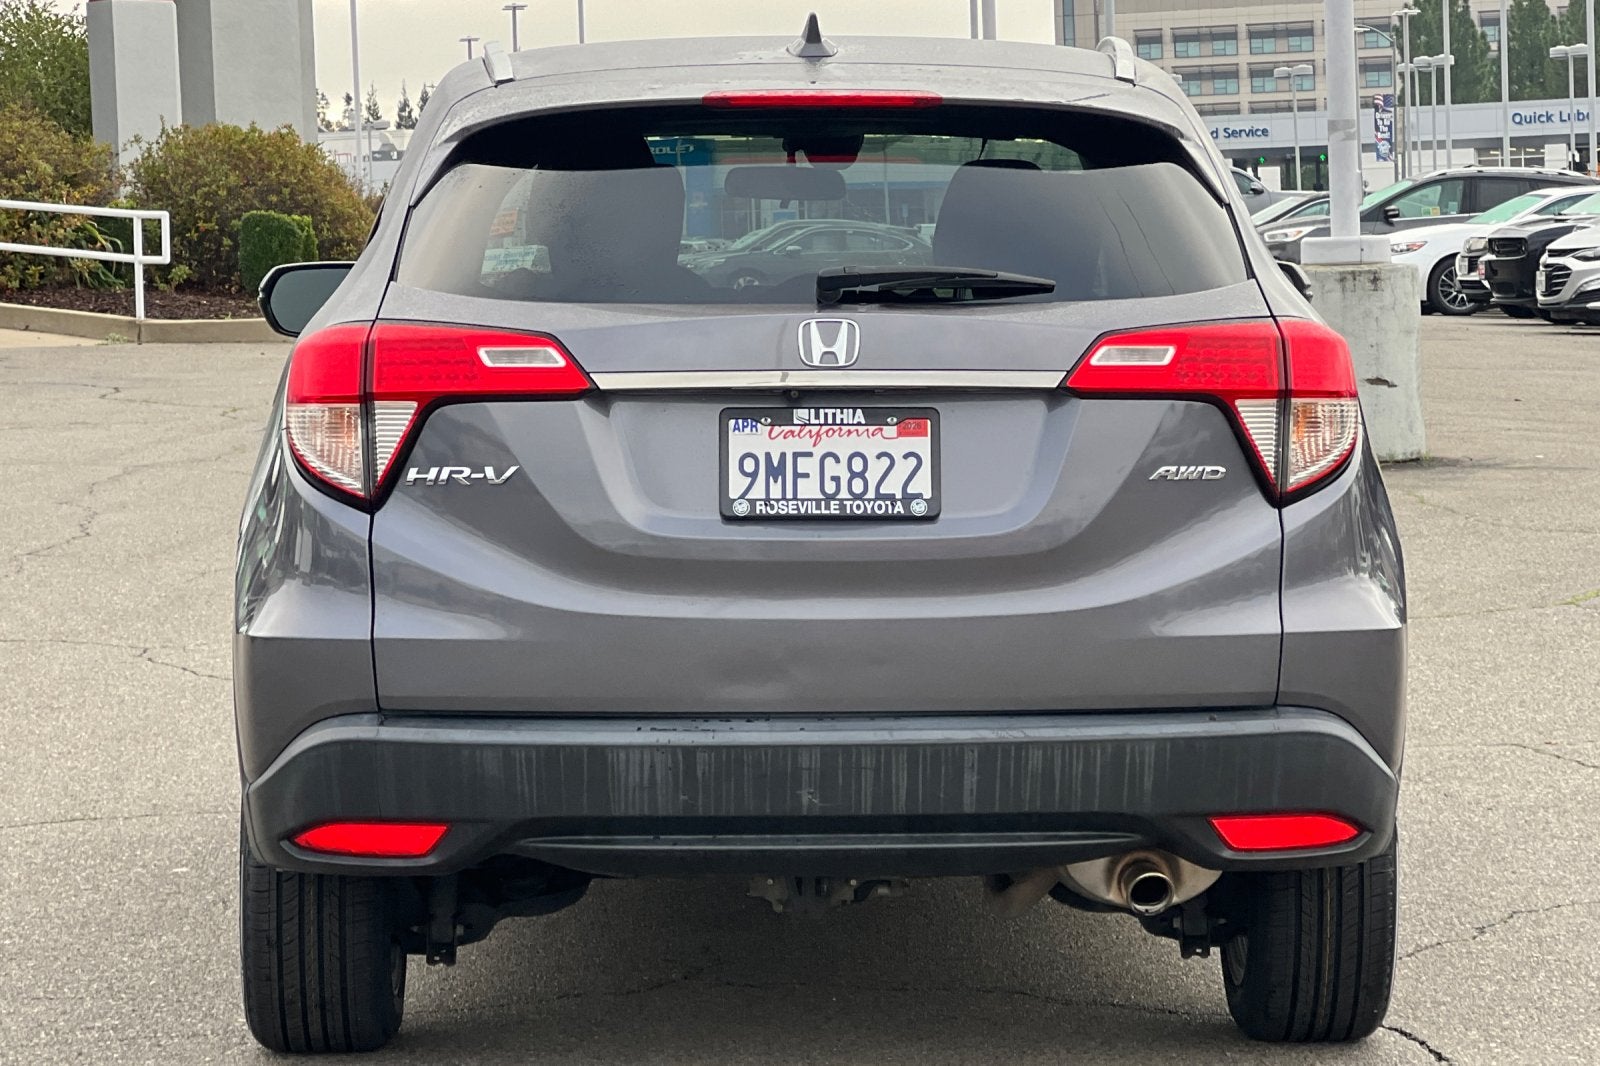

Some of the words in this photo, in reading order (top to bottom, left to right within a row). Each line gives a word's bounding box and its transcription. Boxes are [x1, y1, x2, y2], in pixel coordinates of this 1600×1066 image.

[1512, 110, 1554, 125] Quick
[1560, 109, 1590, 122] Lub
[1223, 126, 1268, 138] Service
[810, 408, 866, 424] LITHIA
[732, 419, 758, 432] APR
[767, 425, 898, 448] California
[405, 465, 520, 486] HR-V
[738, 451, 924, 499] 9MFG822
[1149, 466, 1226, 480] AWD
[756, 500, 840, 514] ROSEVILLE
[843, 500, 904, 514] TOYOTA
